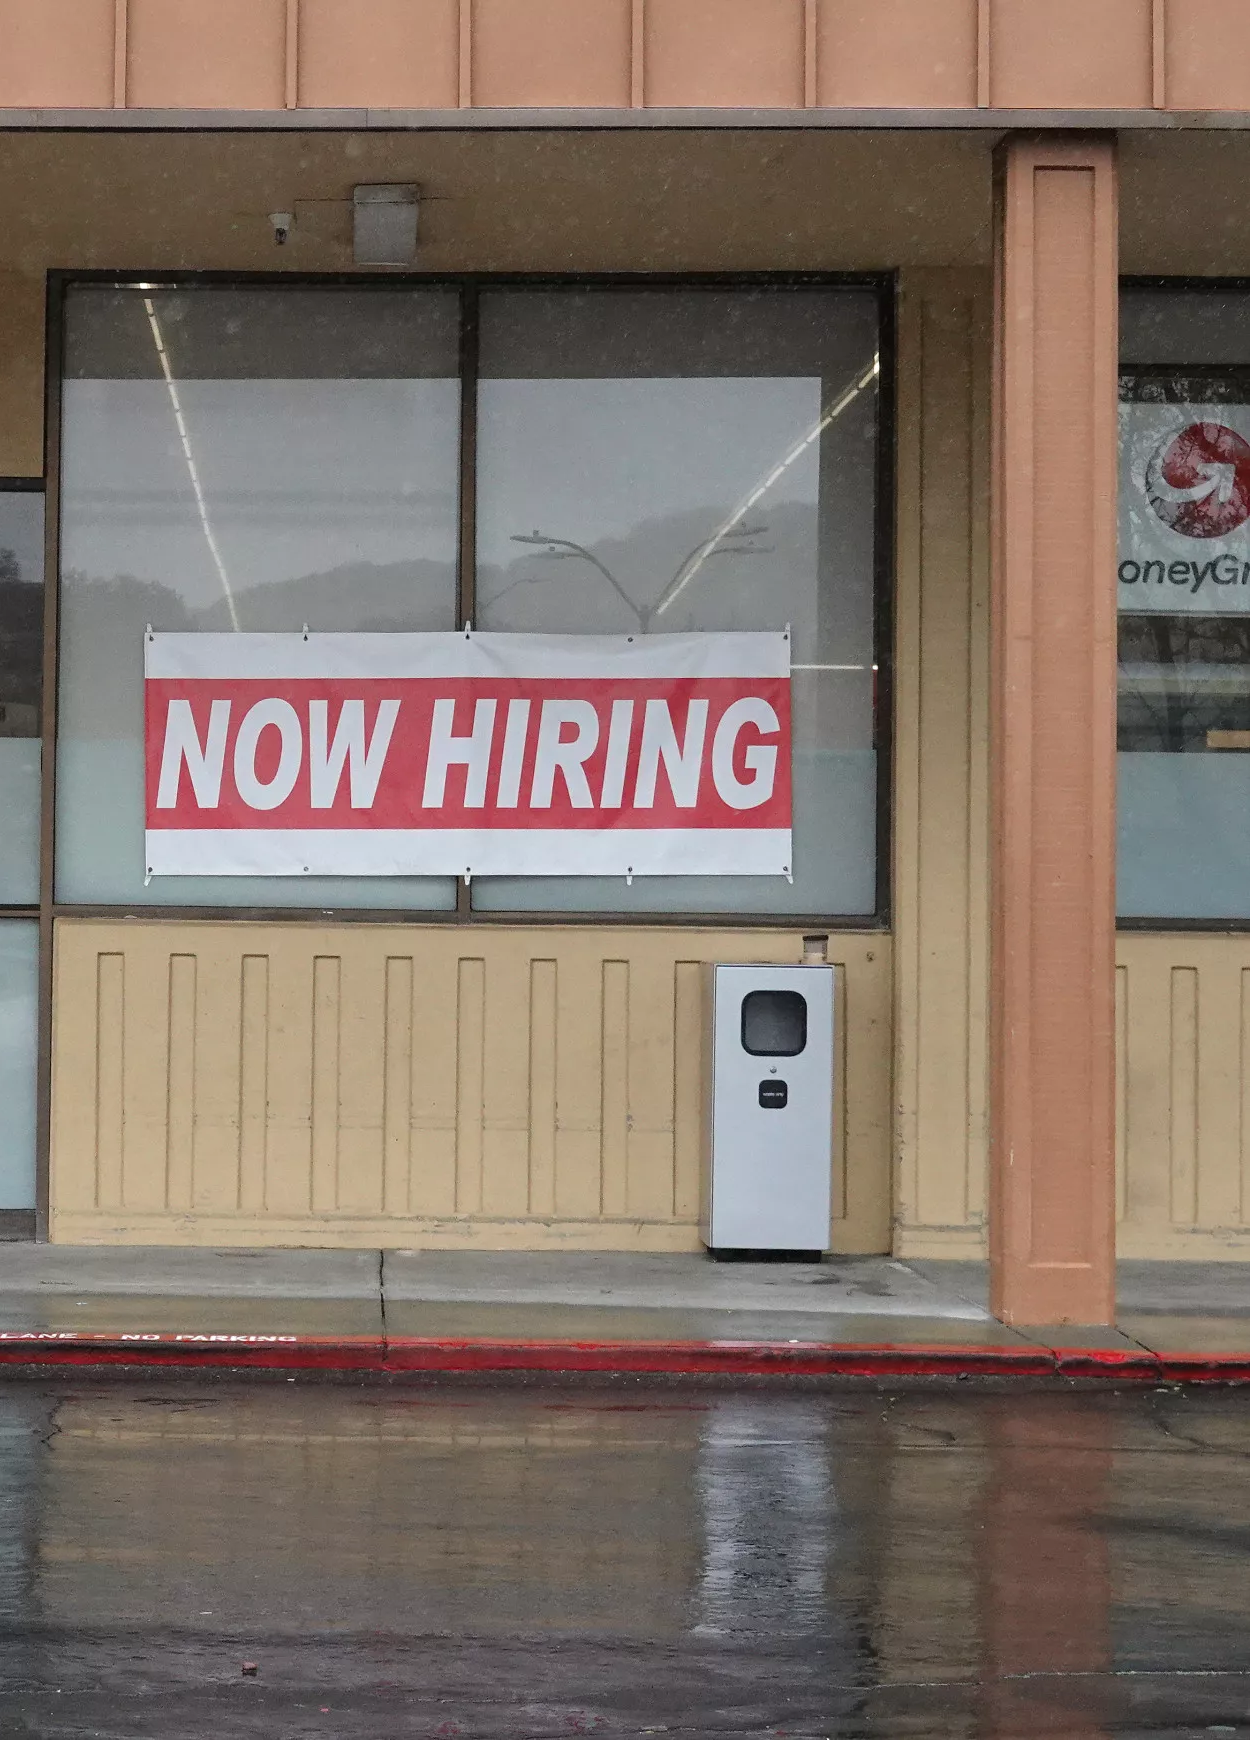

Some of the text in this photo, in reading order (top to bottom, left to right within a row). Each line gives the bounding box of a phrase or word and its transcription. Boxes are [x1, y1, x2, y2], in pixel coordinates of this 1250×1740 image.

[155, 696, 782, 811] NOW HIRING
[0, 1332, 79, 1340] LANE
[175, 1334, 297, 1342] PARKING
